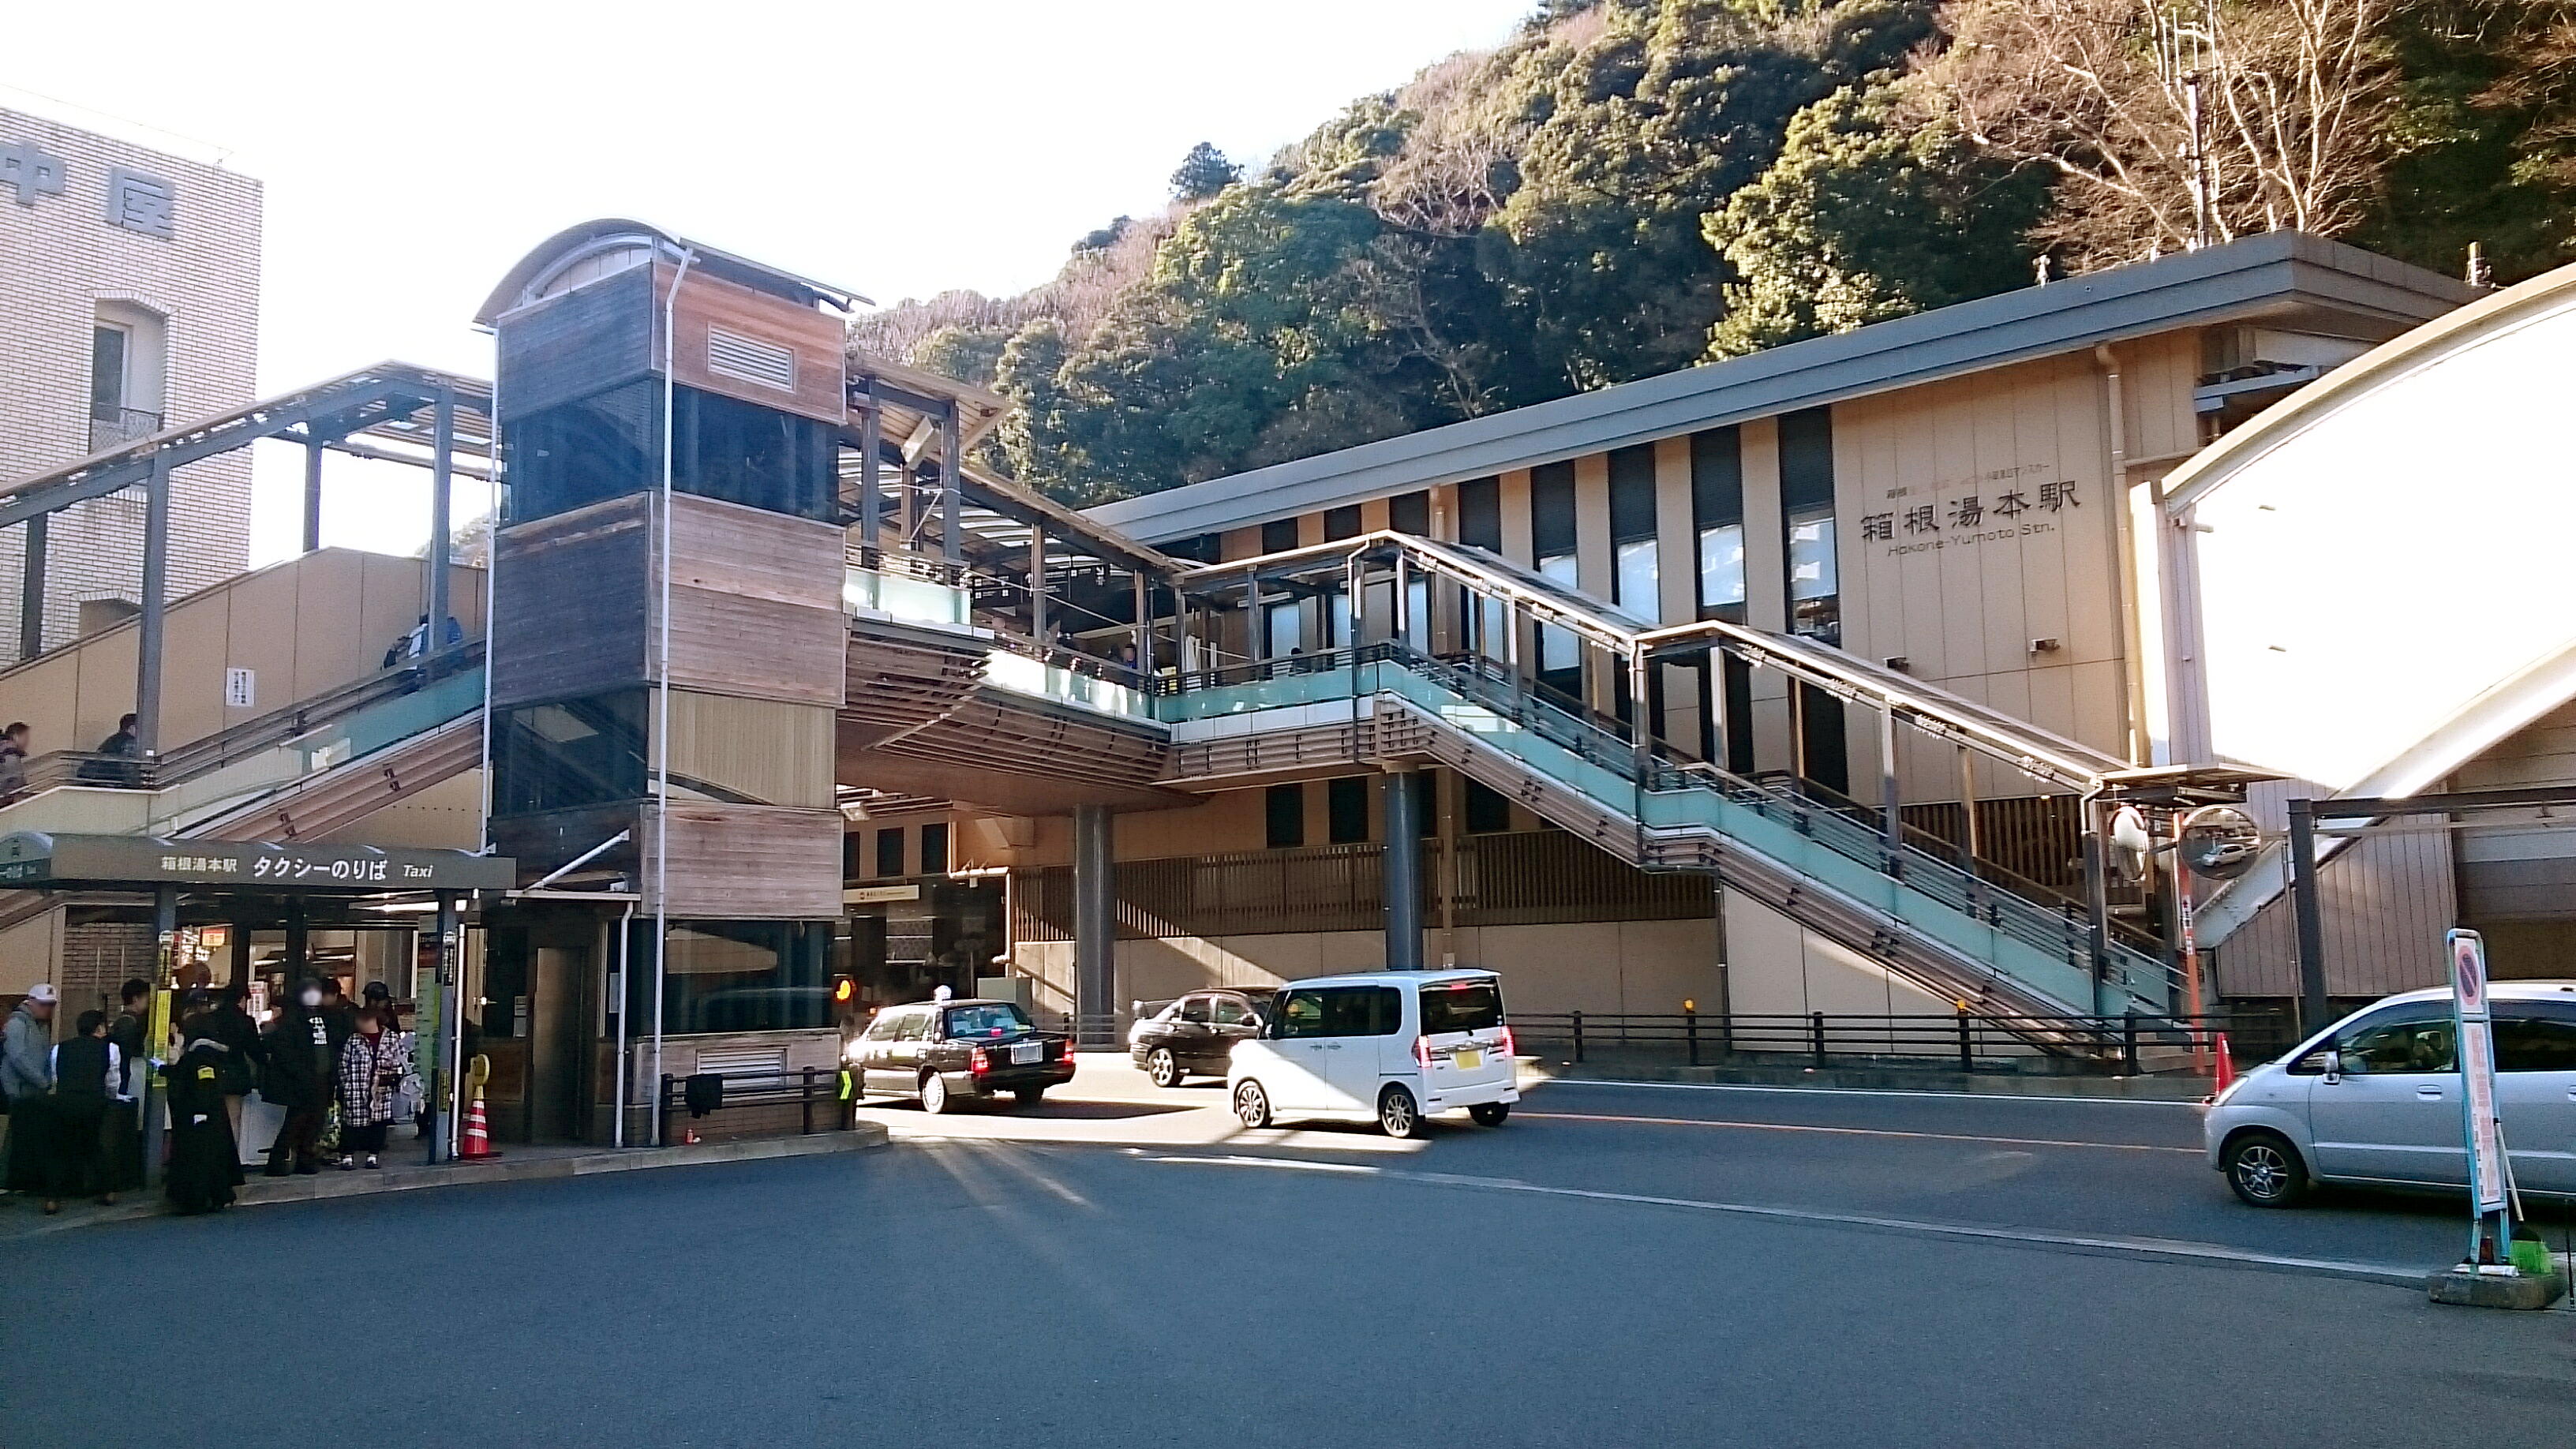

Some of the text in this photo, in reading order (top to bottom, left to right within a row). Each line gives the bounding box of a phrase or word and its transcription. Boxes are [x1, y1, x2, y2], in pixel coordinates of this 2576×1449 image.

[1860, 479, 2081, 543] 箱根湯本駅
[1887, 522, 2055, 556] Hakone-Yumoto Stn.
[161, 856, 434, 880] 箱根湯本駅 タクシーのりば Taxi
